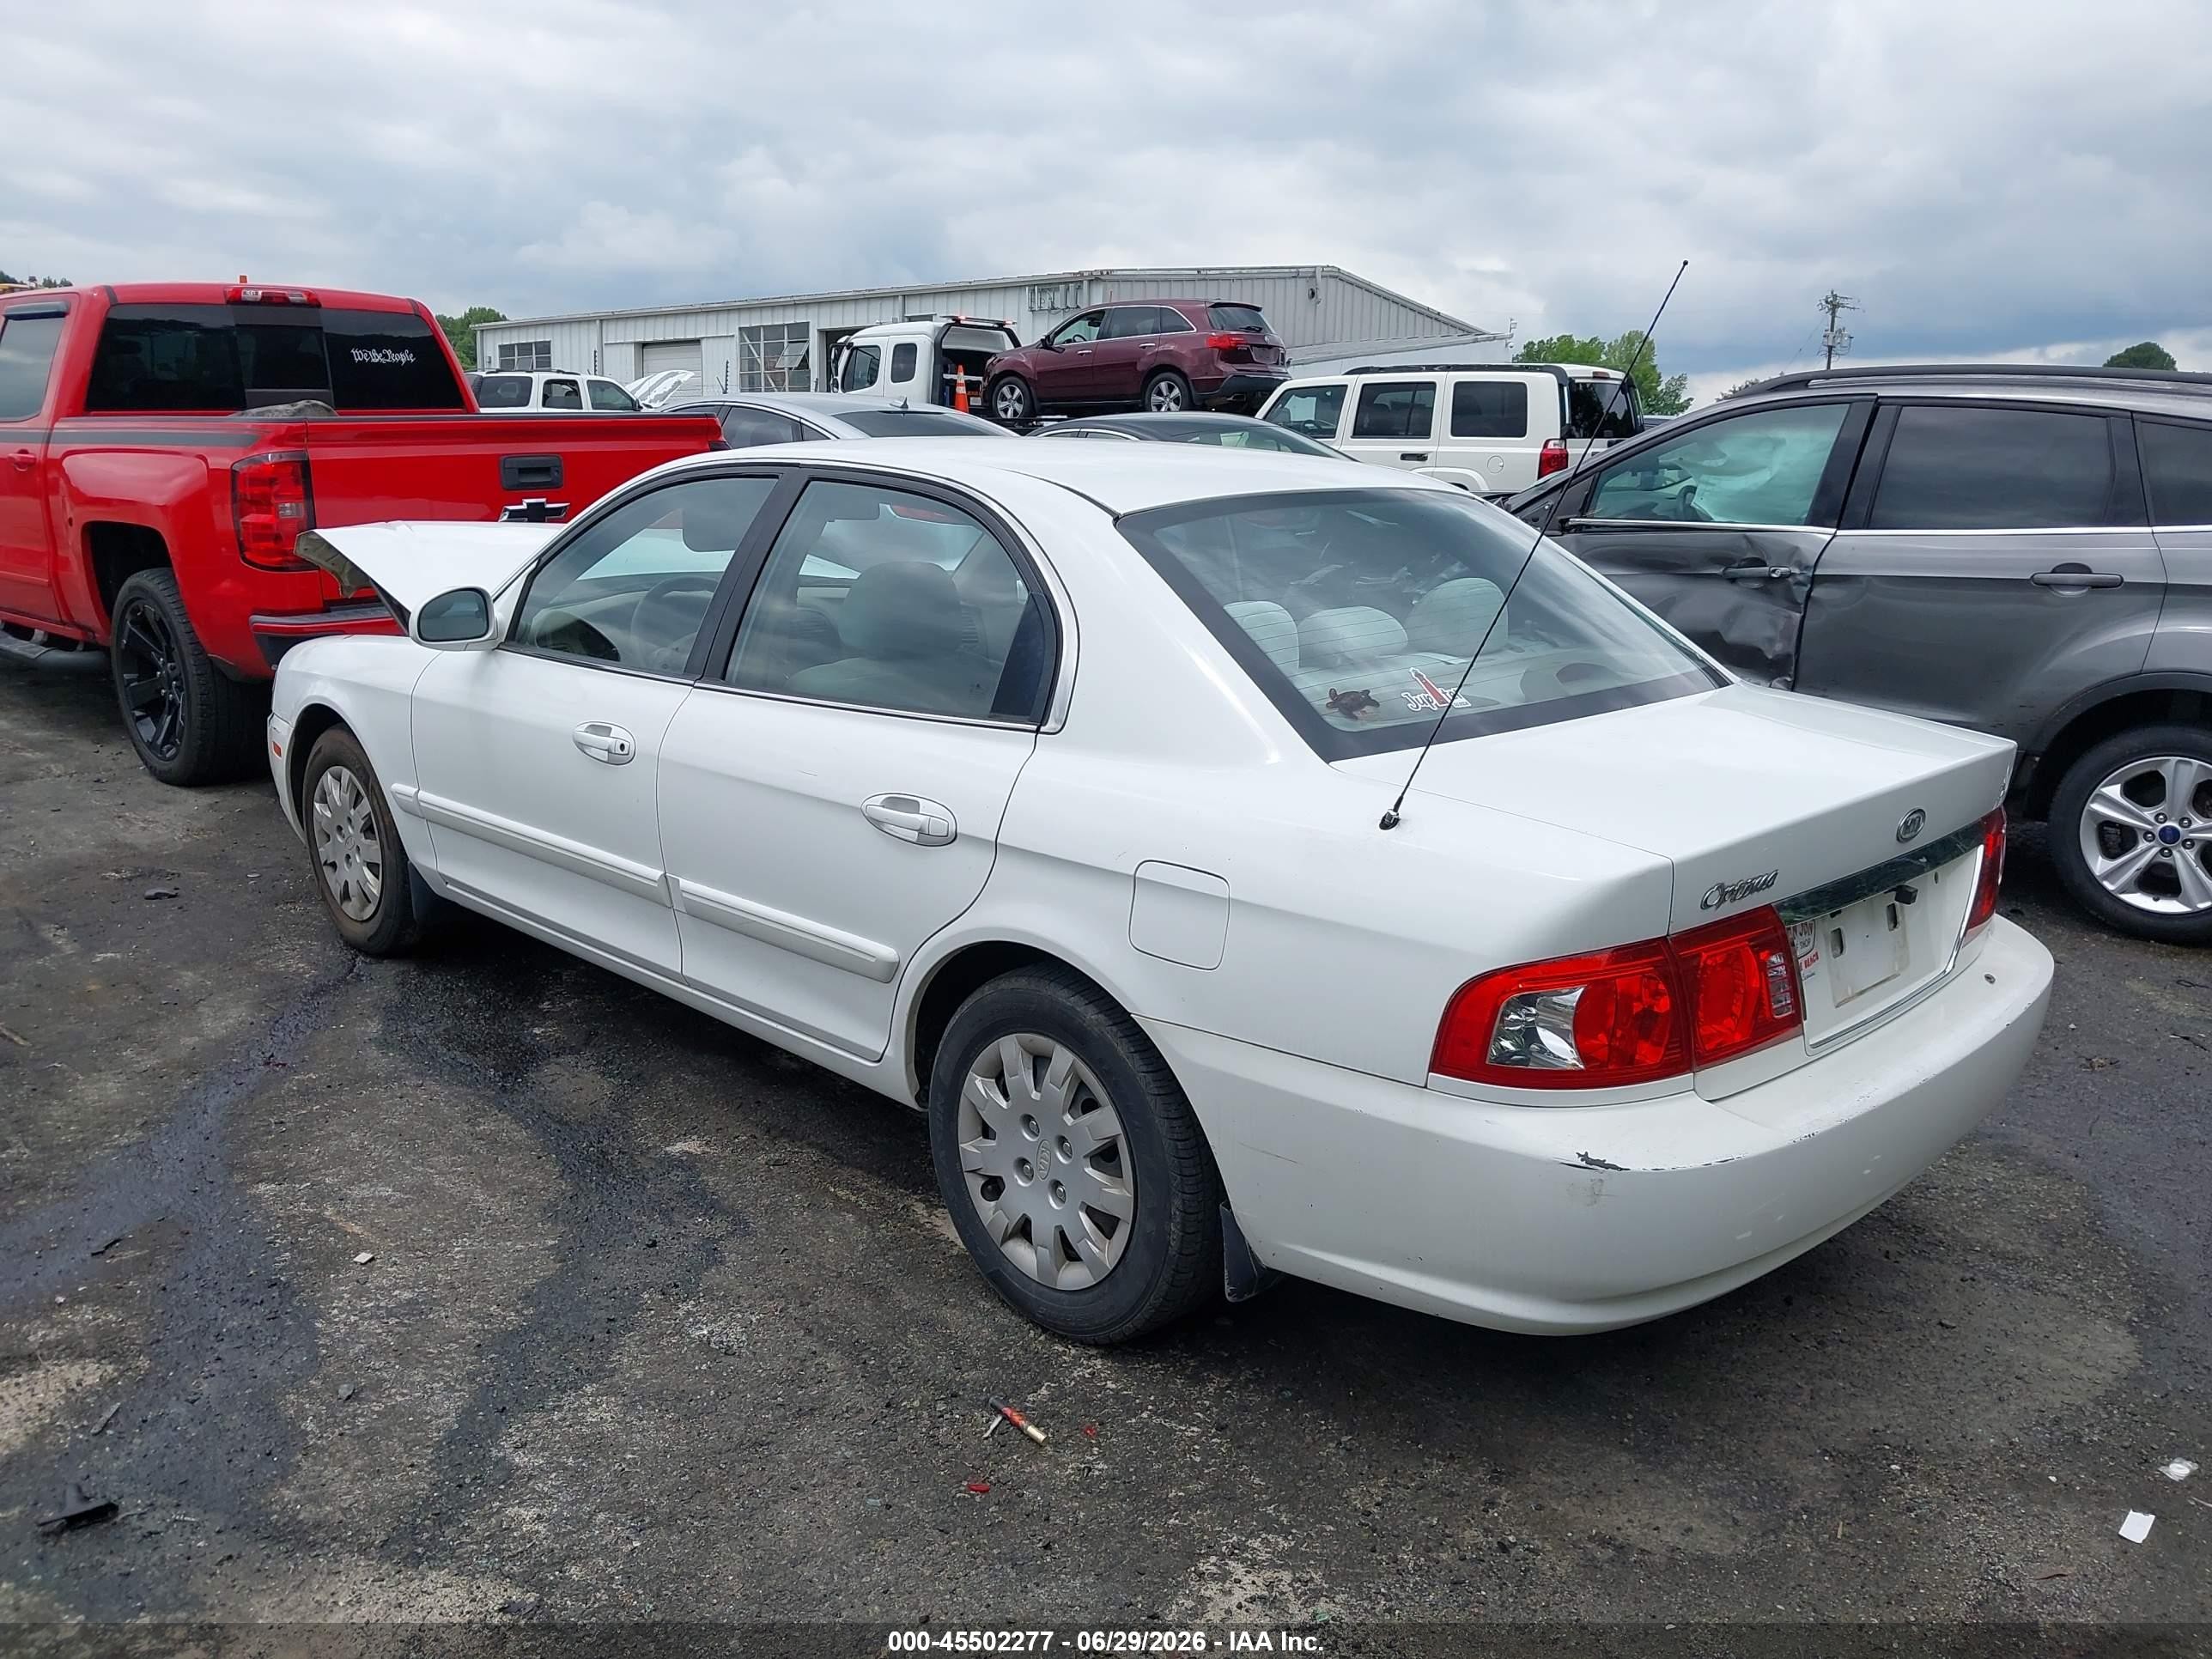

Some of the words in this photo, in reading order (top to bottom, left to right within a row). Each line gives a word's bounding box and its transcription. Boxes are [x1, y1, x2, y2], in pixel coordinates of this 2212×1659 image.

[350, 348, 370, 363] We
[382, 349, 416, 367] People
[1700, 869, 1779, 910] Optima
